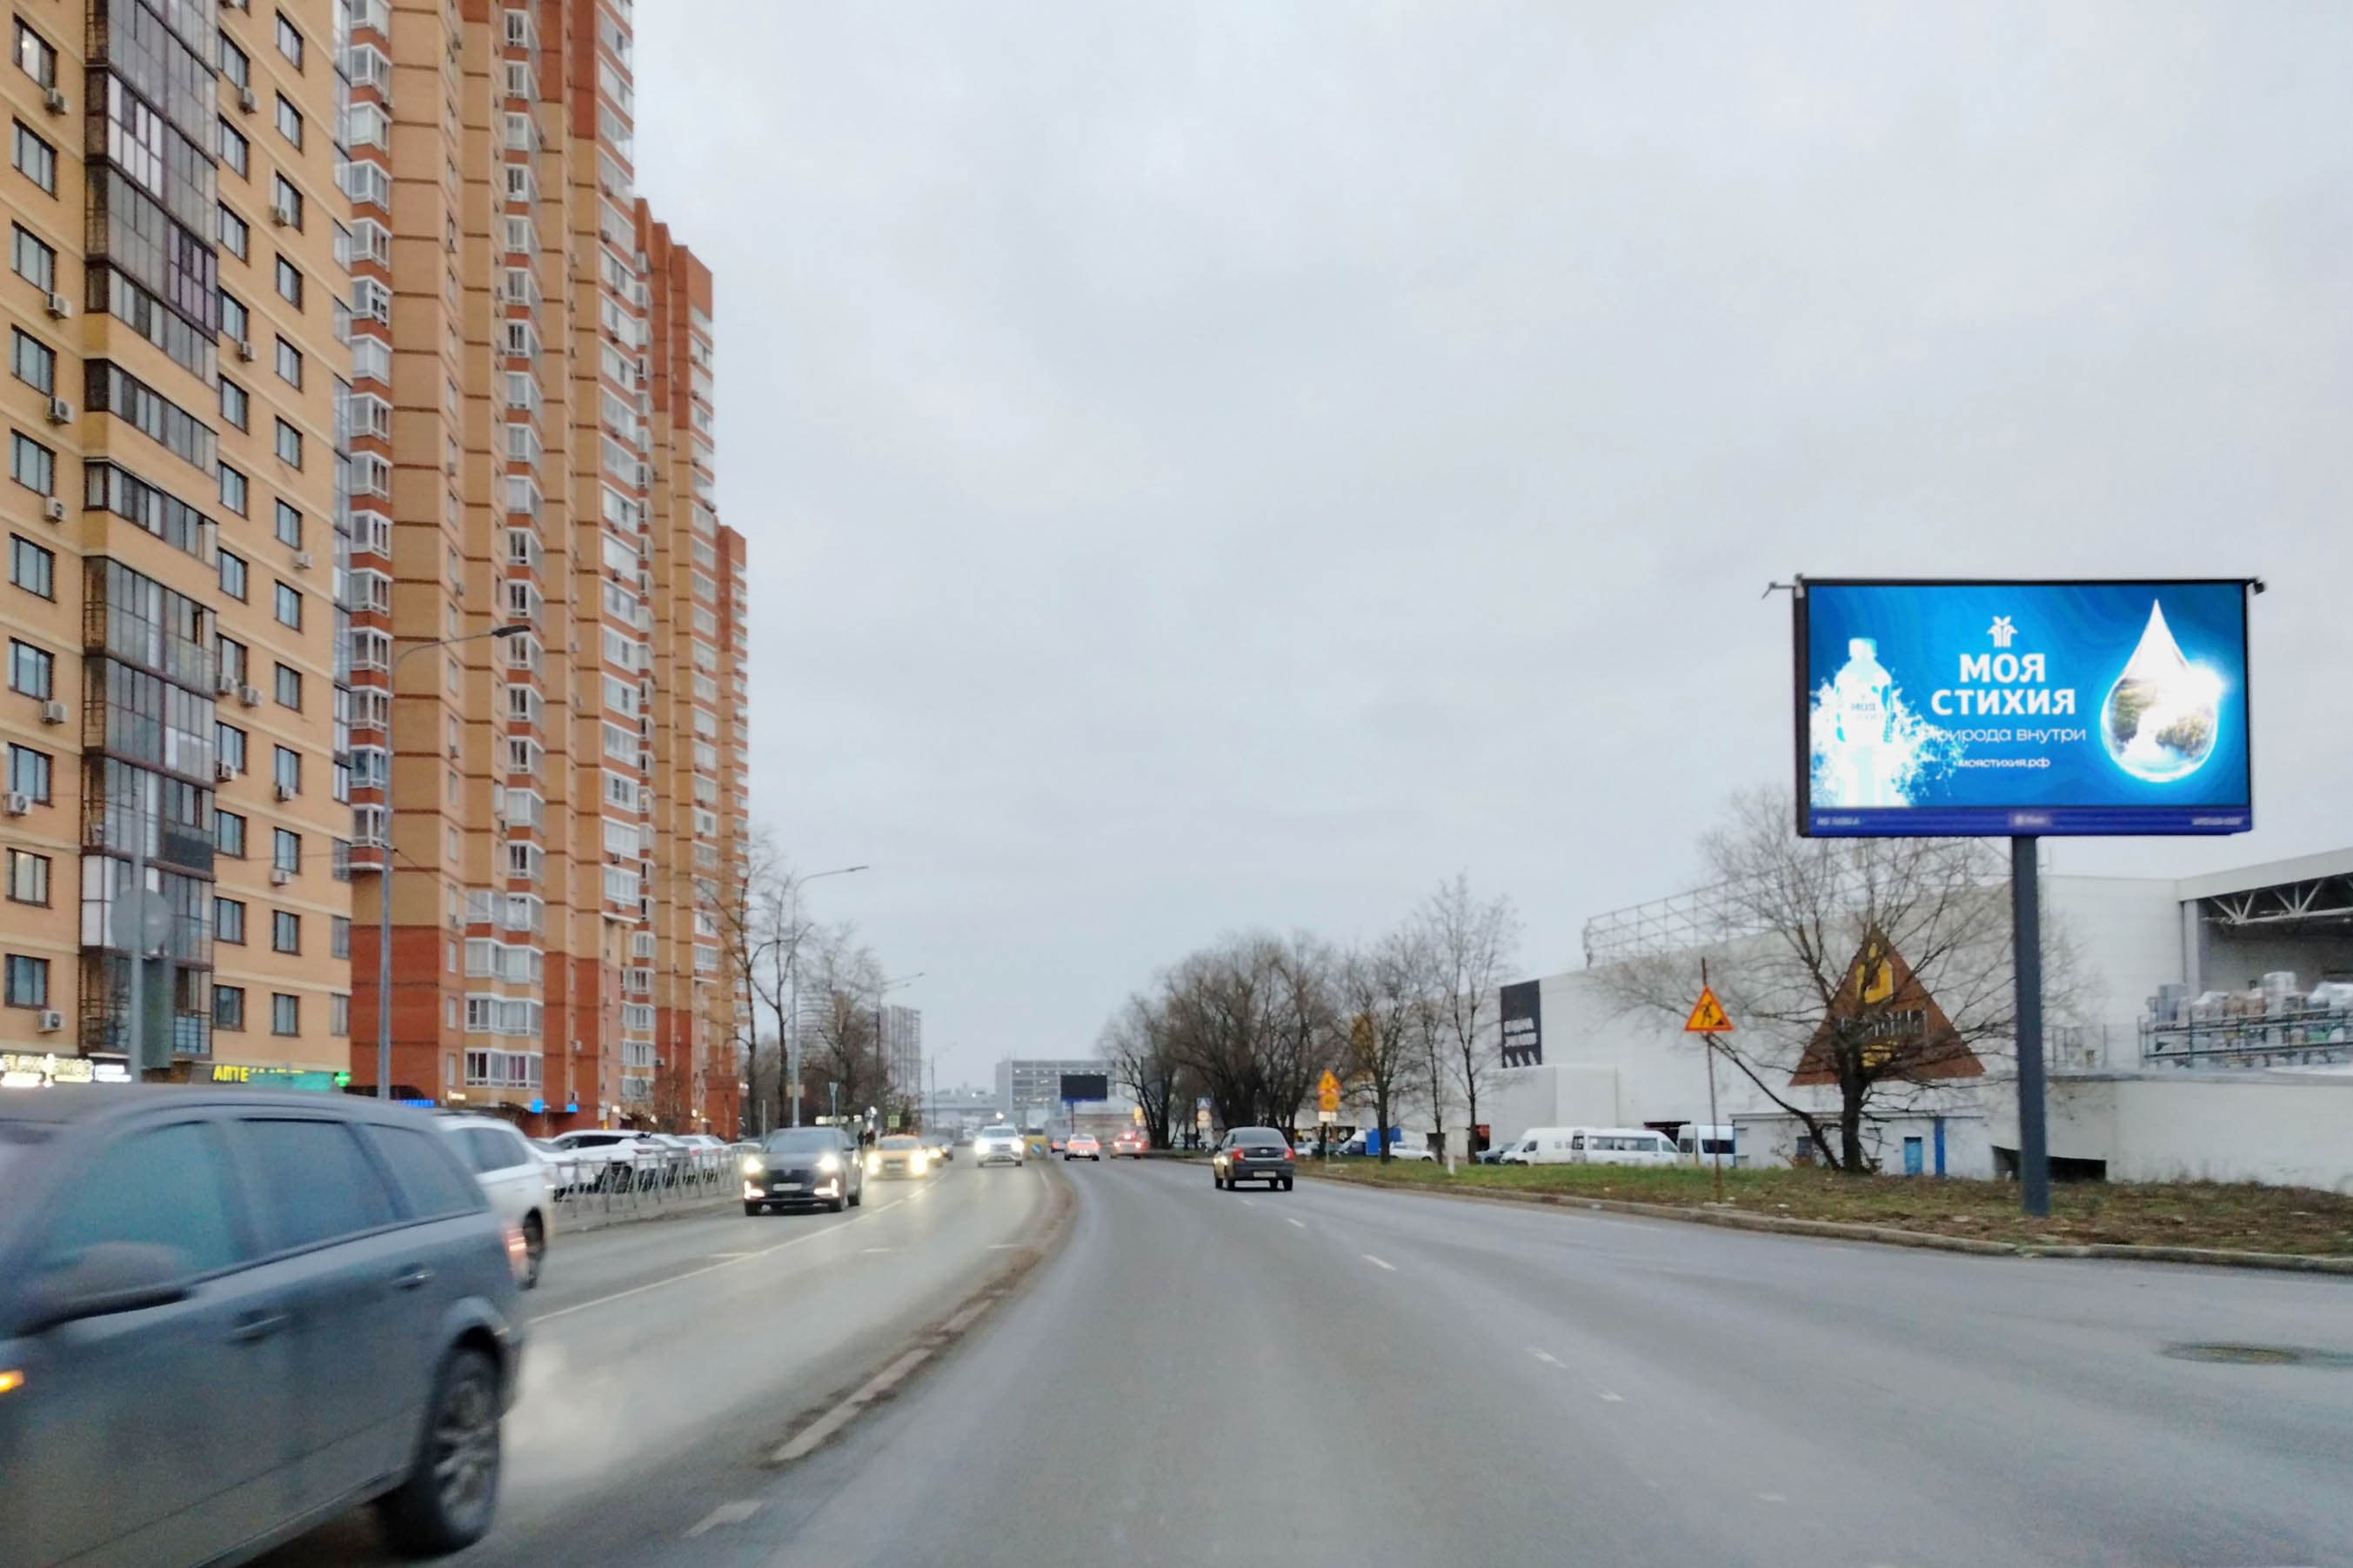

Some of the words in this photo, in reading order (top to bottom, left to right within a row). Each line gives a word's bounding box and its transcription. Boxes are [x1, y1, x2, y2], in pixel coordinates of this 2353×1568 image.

[1959, 653, 2046, 684] МОЯ
[1930, 688, 2076, 716] СТИХИЯ
[1929, 728, 2012, 744] рирода
[2015, 728, 2087, 744] внутри
